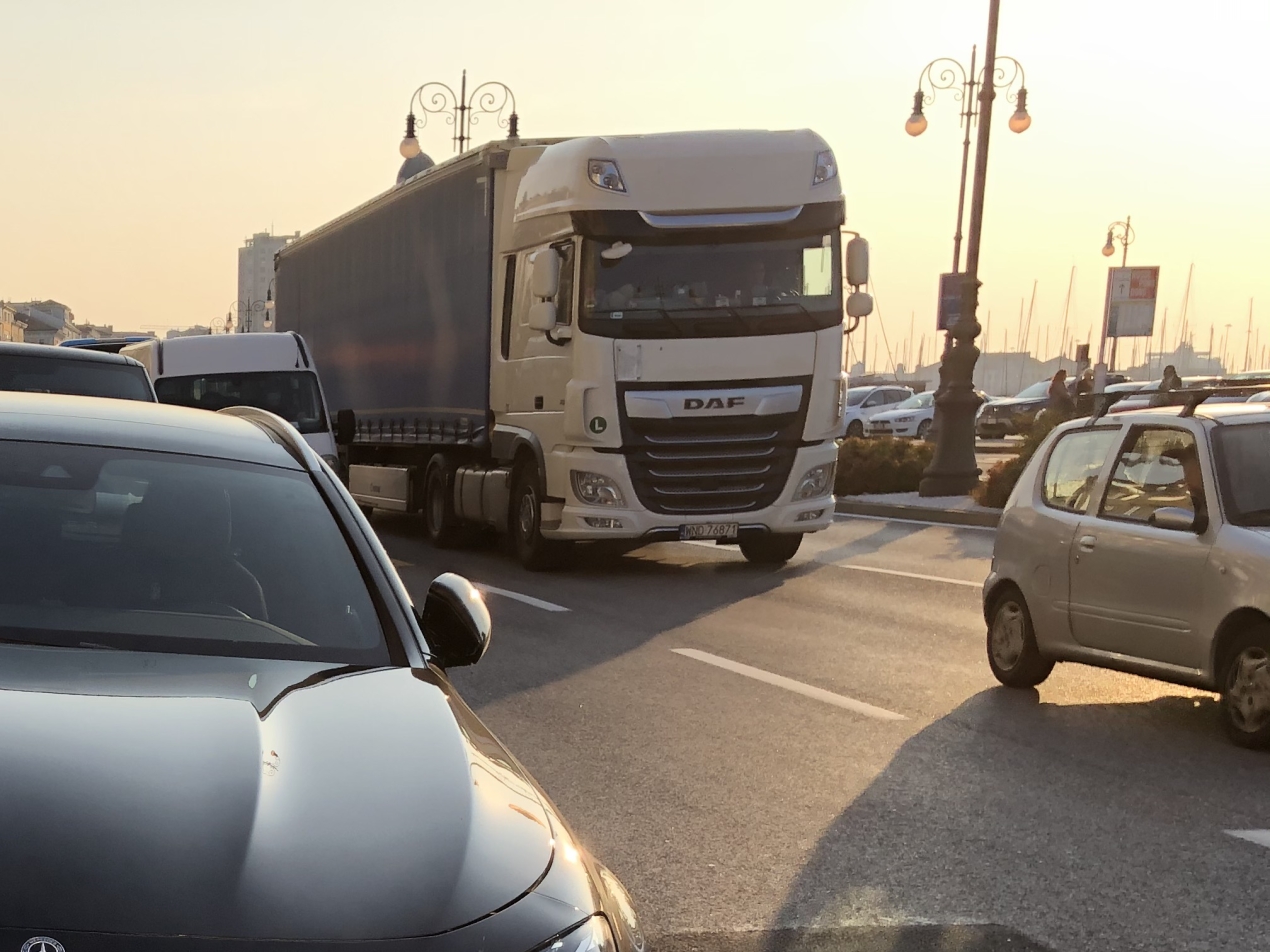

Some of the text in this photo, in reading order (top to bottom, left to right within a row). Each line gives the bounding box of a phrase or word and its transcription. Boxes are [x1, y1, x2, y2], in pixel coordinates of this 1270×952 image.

[684, 397, 745, 410] DAF
[595, 419, 603, 430] L
[707, 524, 736, 535] 76871
